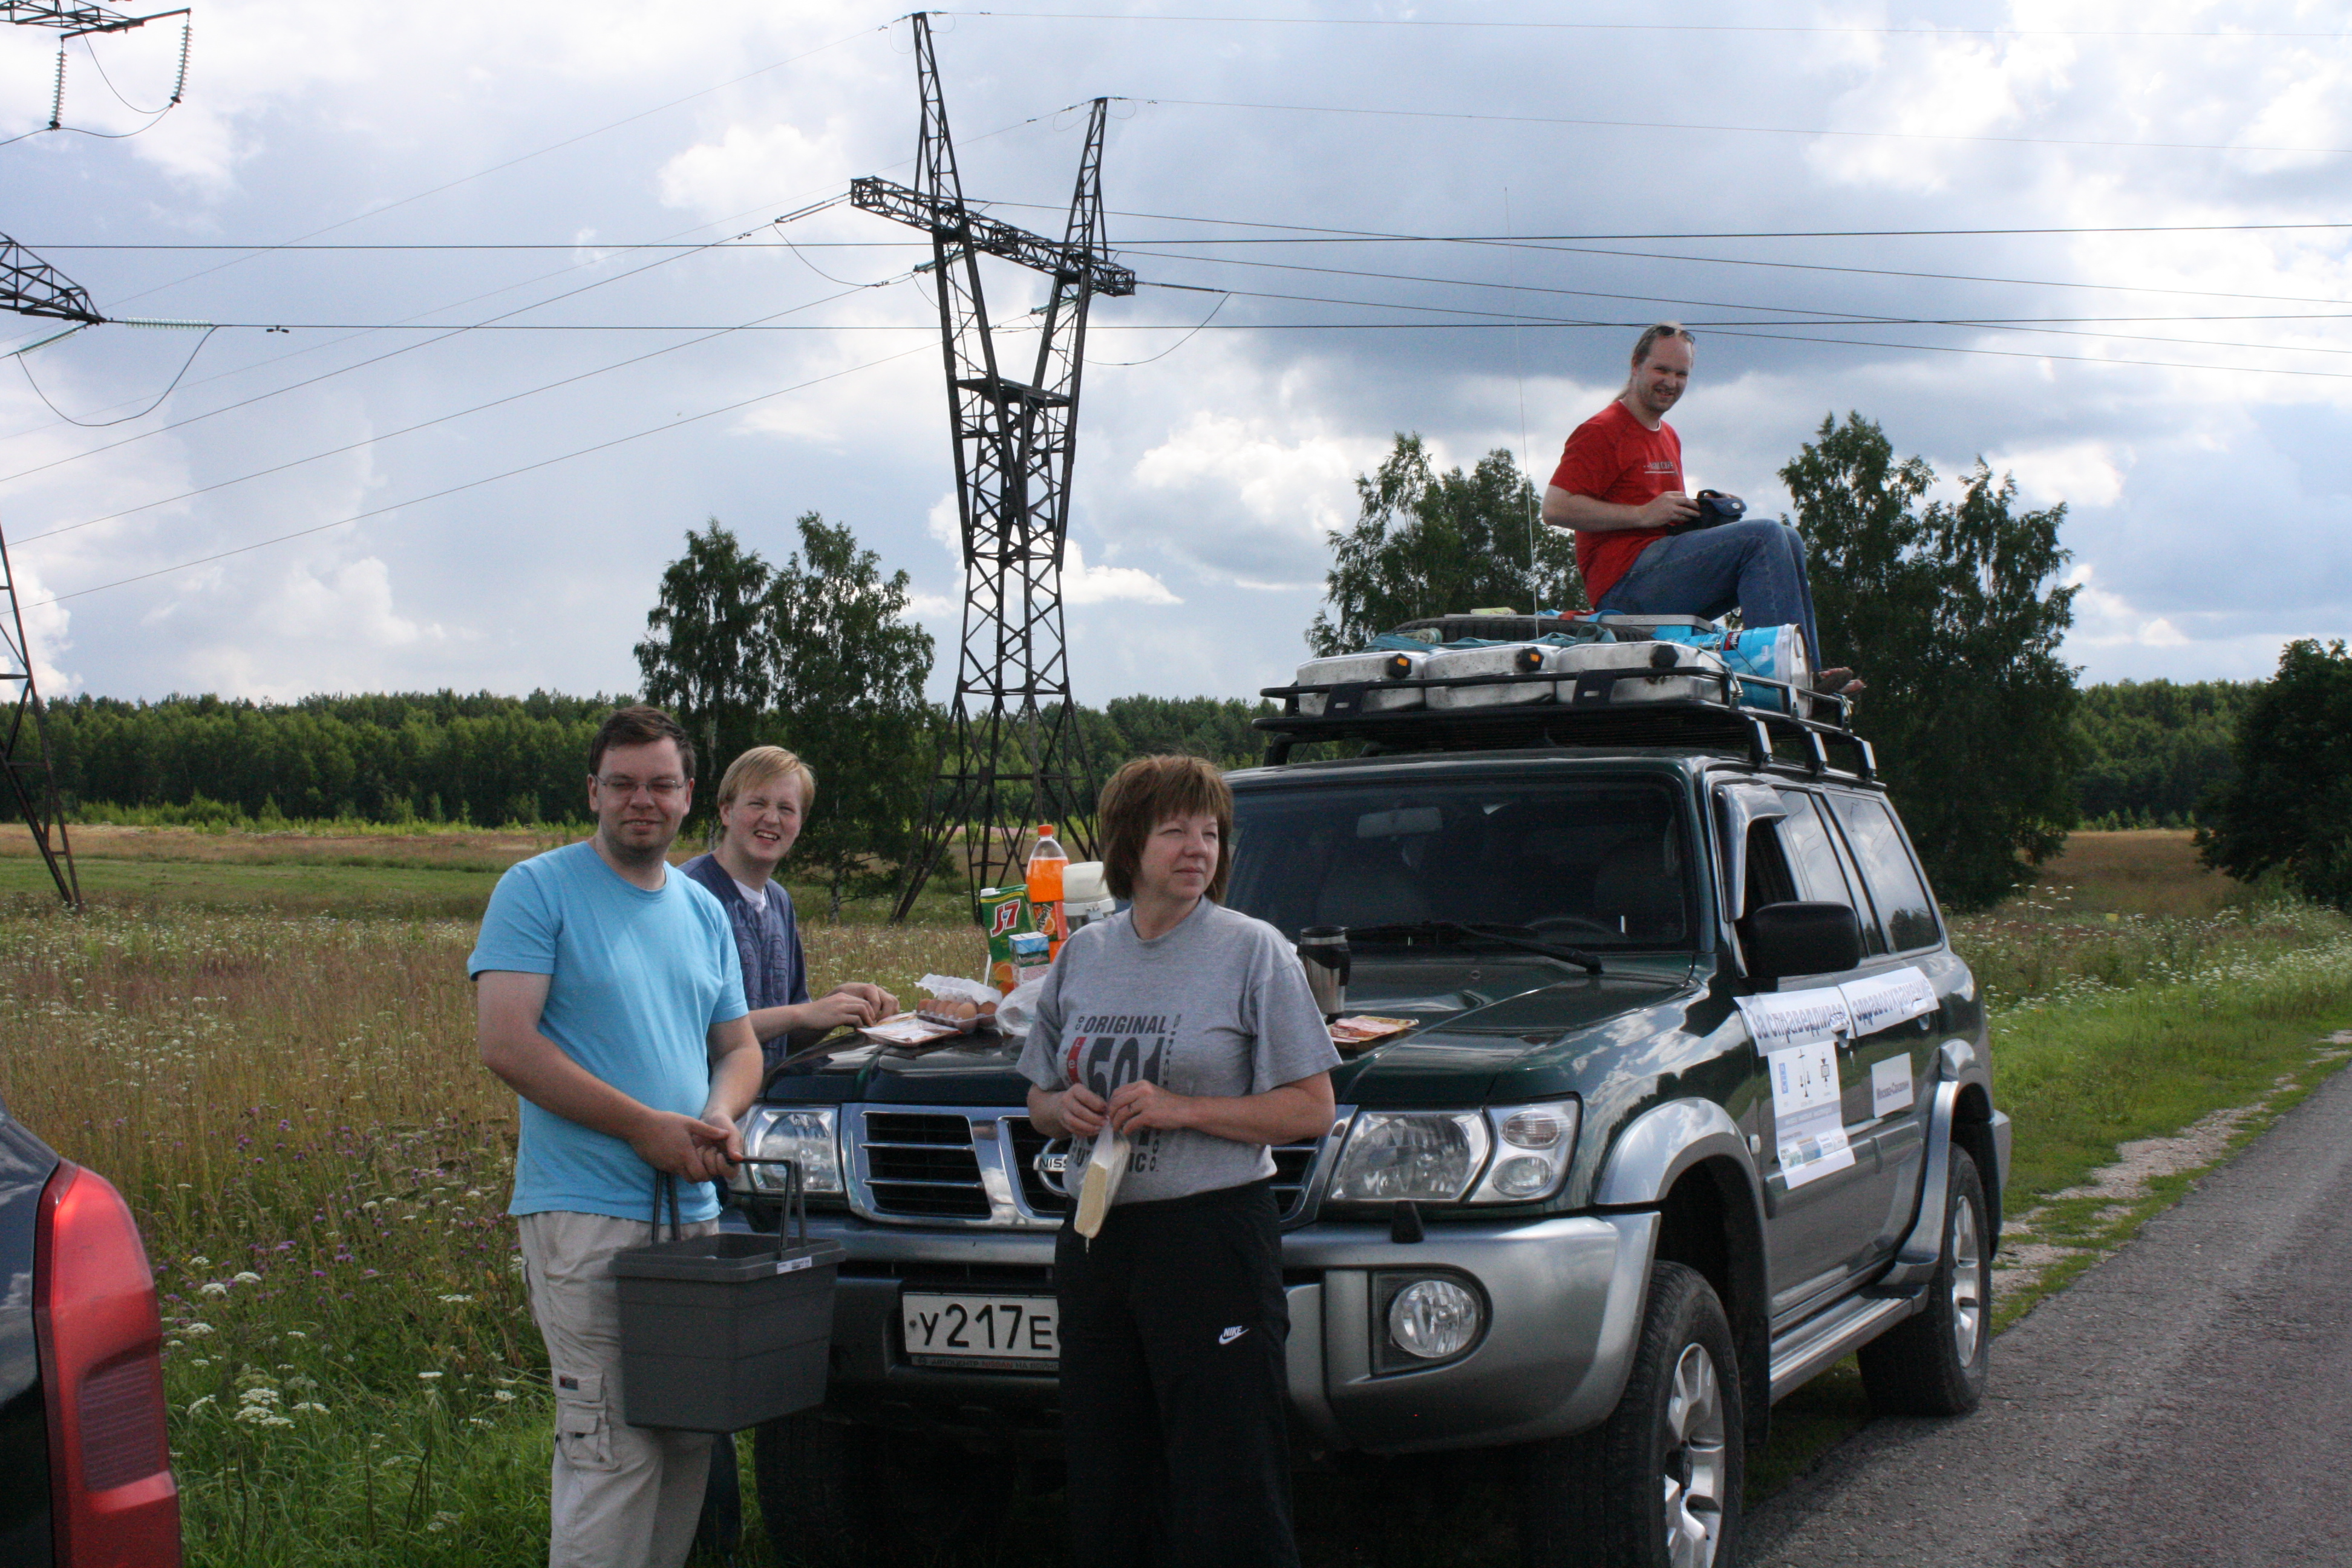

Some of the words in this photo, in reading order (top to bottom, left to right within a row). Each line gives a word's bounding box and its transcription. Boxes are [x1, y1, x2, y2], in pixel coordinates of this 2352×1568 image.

[1747, 1008, 1770, 1040] За
[1852, 978, 1934, 1026] здравоохранение
[1083, 1015, 1166, 1034] ORIGINAL
[1223, 1325, 1243, 1338] NIKE
[982, 1361, 1013, 1370] NISSAN
